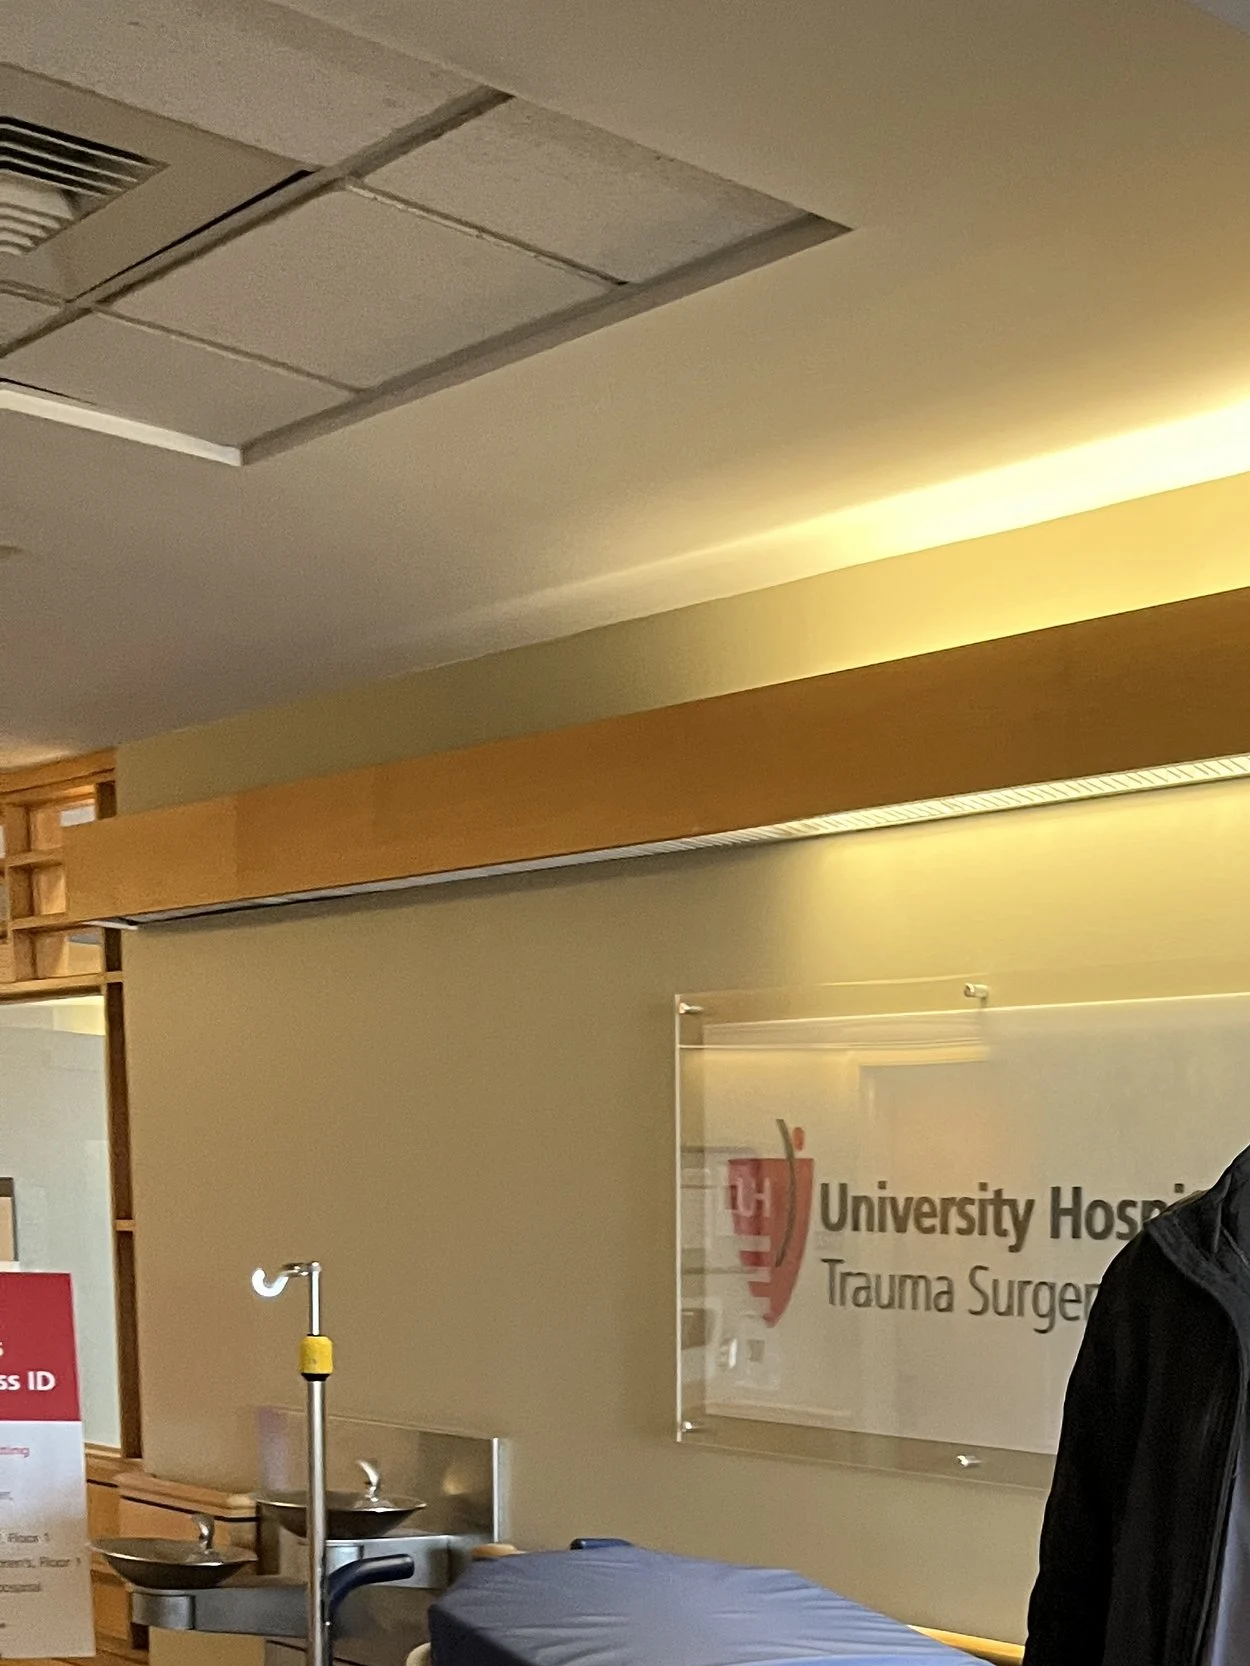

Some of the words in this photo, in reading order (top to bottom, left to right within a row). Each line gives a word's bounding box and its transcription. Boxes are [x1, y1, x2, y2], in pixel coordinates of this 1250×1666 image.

[820, 1180, 1036, 1253] University
[820, 1257, 955, 1314] Trauma
[27, 1370, 57, 1392] ID
